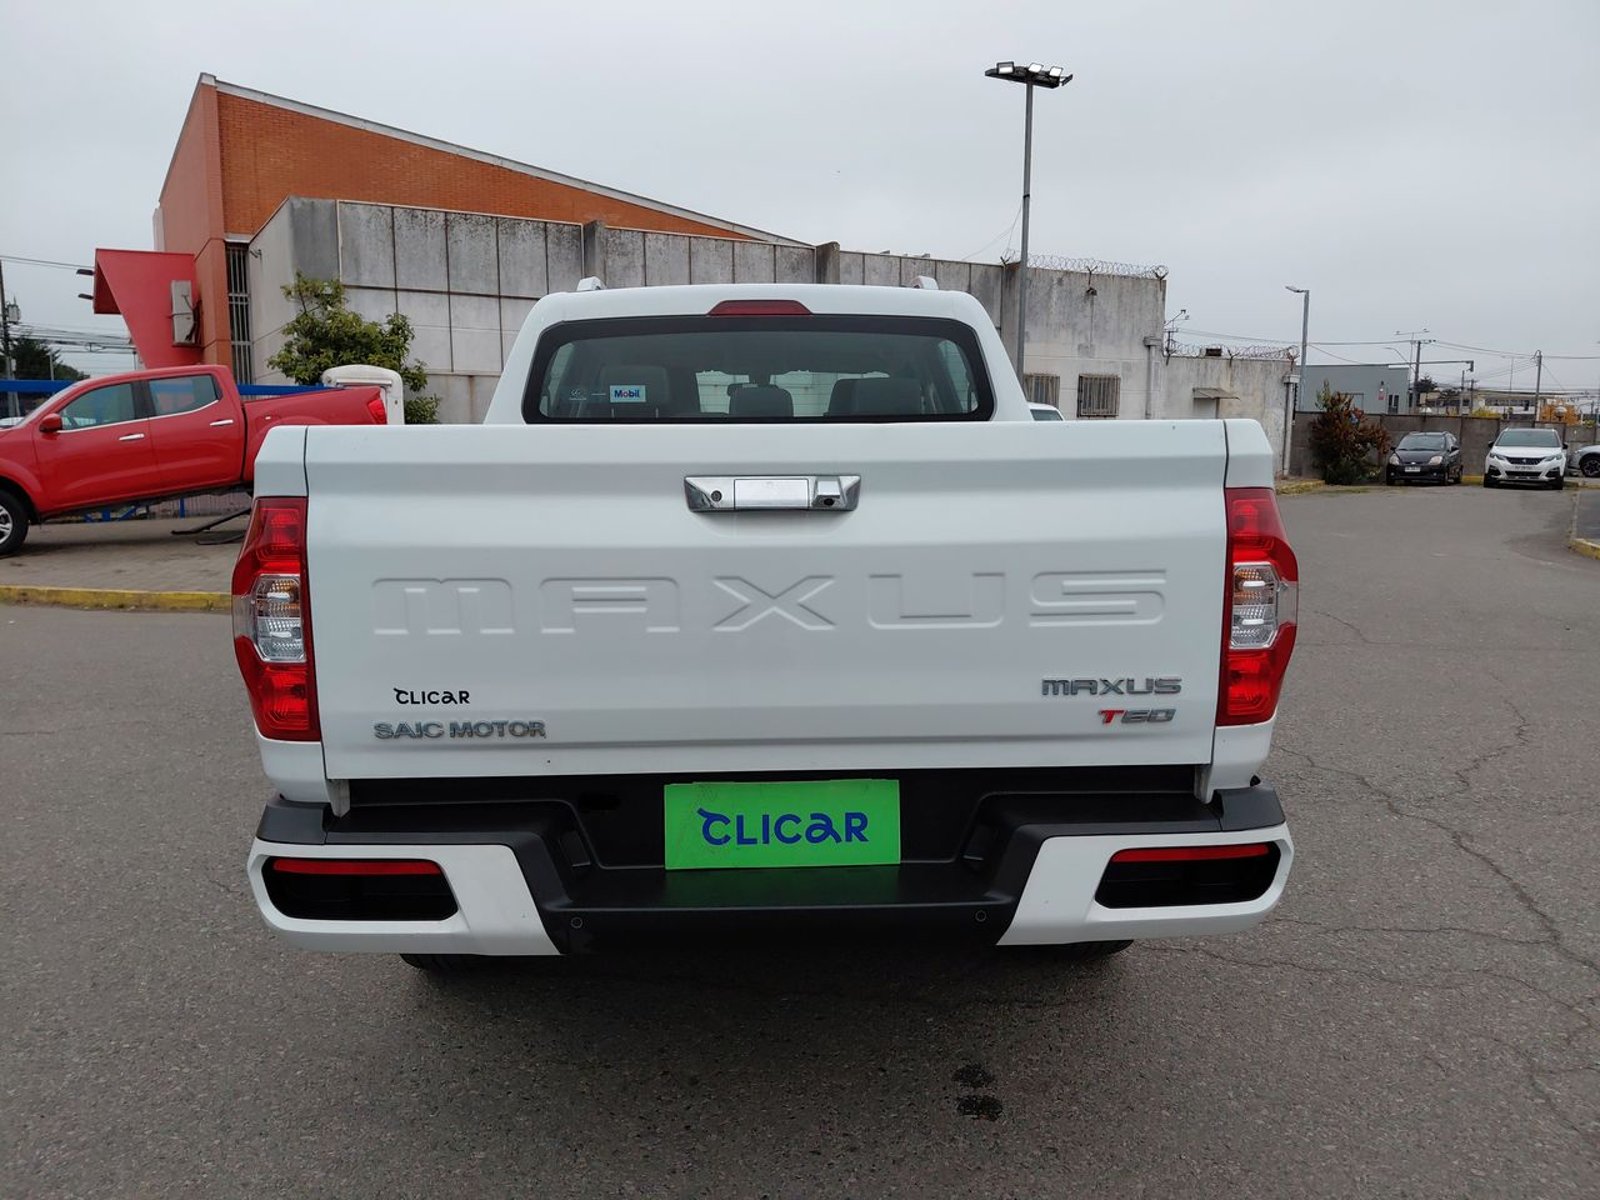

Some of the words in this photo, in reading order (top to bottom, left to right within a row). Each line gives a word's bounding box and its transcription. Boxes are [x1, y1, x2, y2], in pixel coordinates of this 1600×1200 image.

[613, 389, 640, 398] Mobil
[372, 569, 1167, 635] MAXUS
[1041, 678, 1183, 697] MAXUS
[1097, 707, 1178, 725] T60
[373, 720, 445, 740] SAIC
[449, 719, 547, 739] MOTOR
